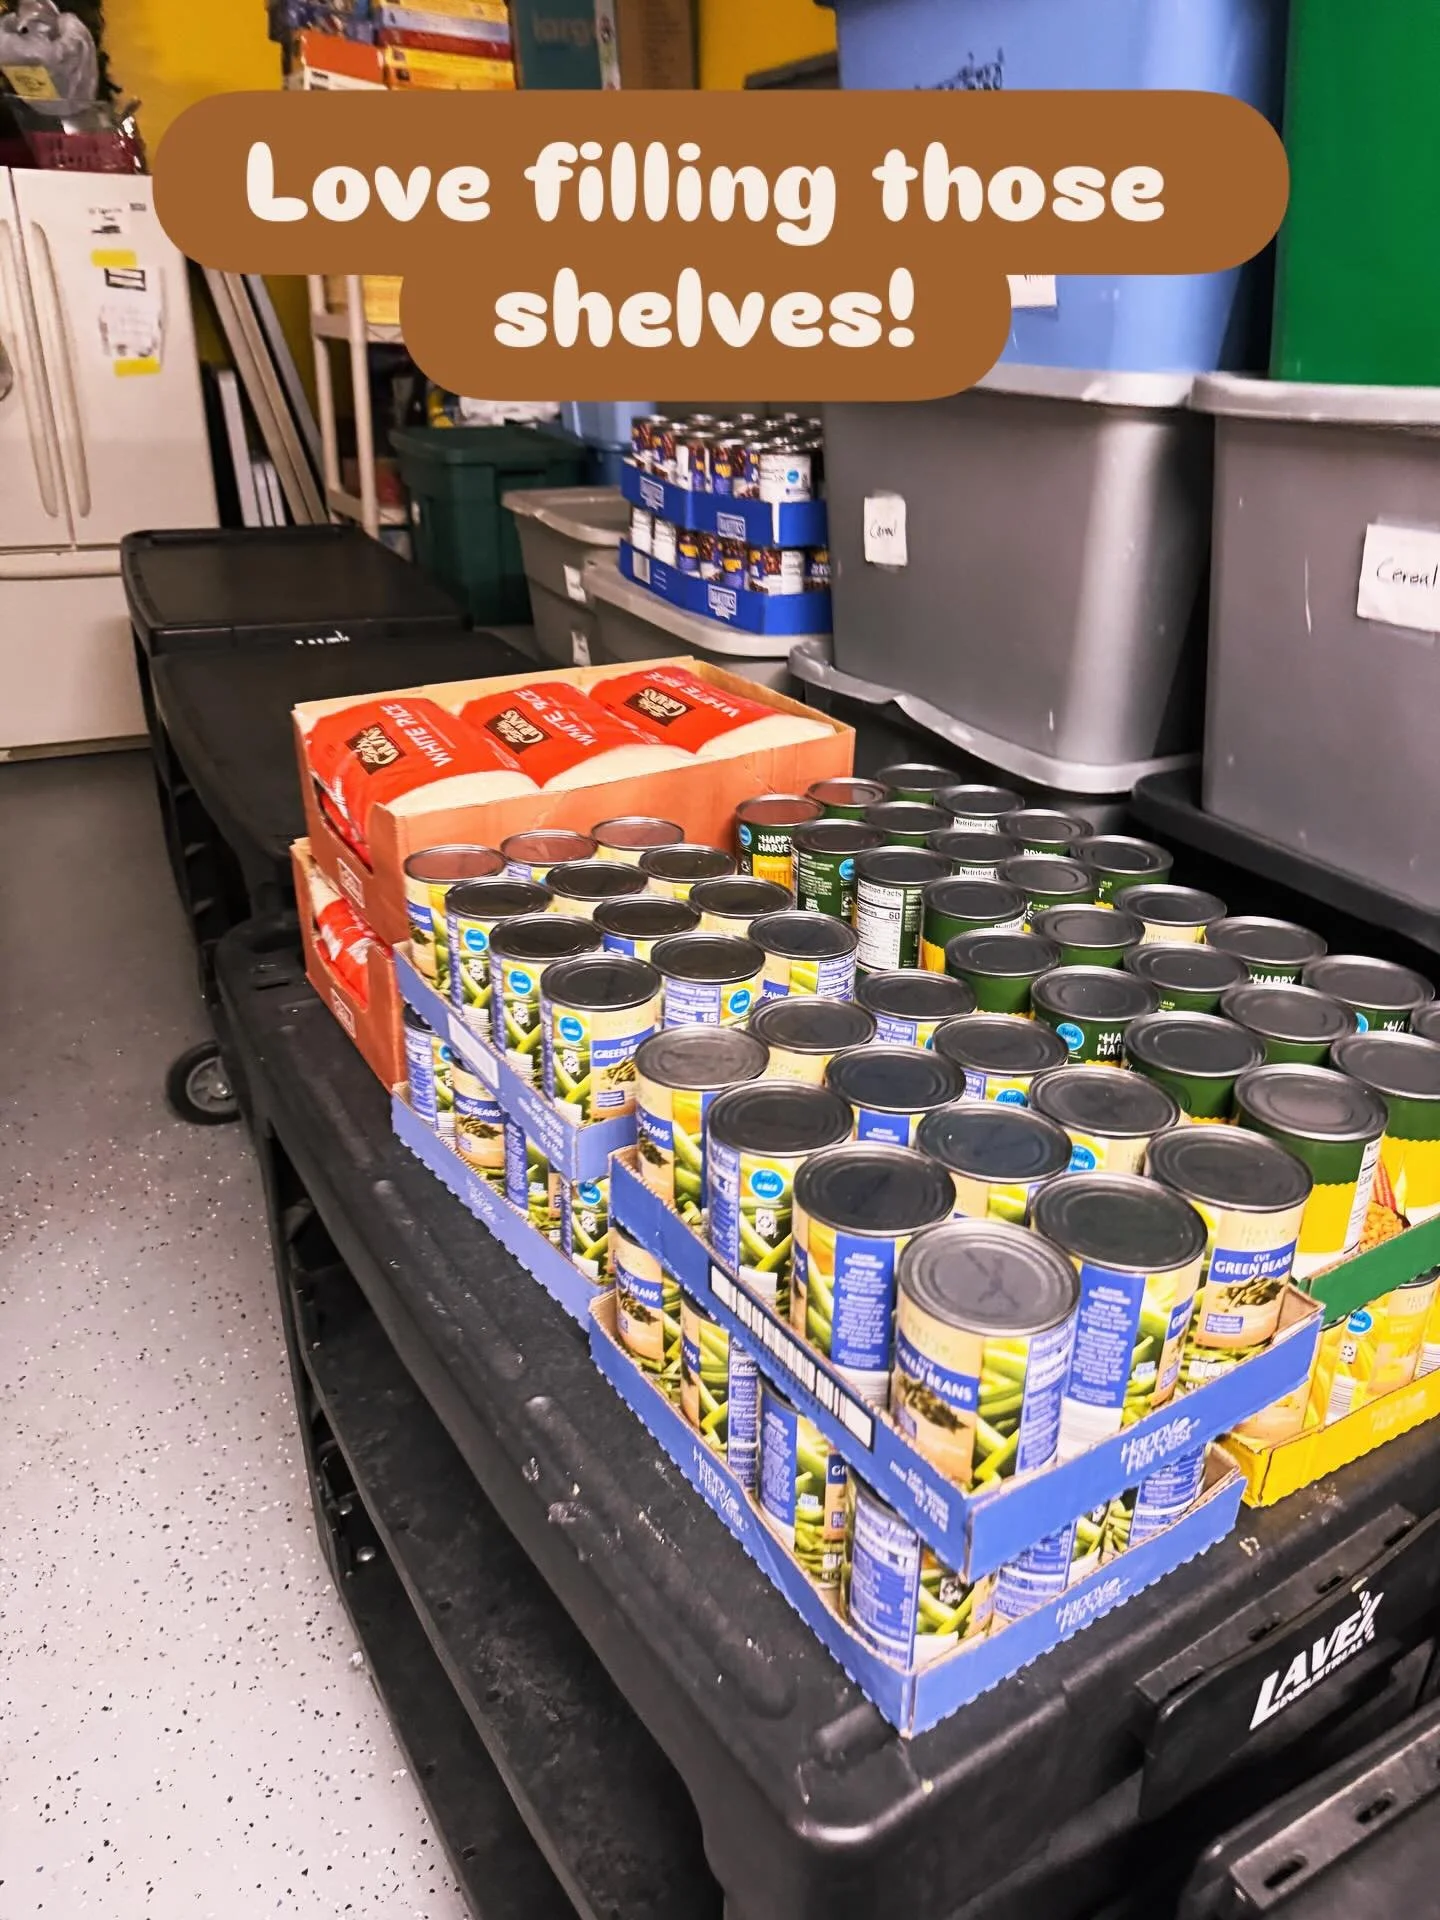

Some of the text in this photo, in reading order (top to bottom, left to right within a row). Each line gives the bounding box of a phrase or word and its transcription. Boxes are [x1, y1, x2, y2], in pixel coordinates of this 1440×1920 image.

[532, 10, 599, 47] larg
[1376, 557, 1439, 588] Cereal
[680, 687, 740, 718] WHITE
[513, 688, 598, 746] WHITE RICE
[380, 703, 454, 768] WHITE RICE
[757, 842, 791, 853] HARVE
[758, 835, 793, 844] HAPPY
[961, 868, 992, 877] Nutrition
[883, 888, 902, 897] Facts
[888, 911, 901, 920] 60
[702, 1012, 717, 1024] 15
[594, 1047, 627, 1059] GREEN
[1214, 1252, 1293, 1276] GREEN BEANS
[1253, 1253, 1271, 1263] CUT
[926, 1369, 973, 1403] BEANS
[1249, 1591, 1385, 1731] LAVEX
